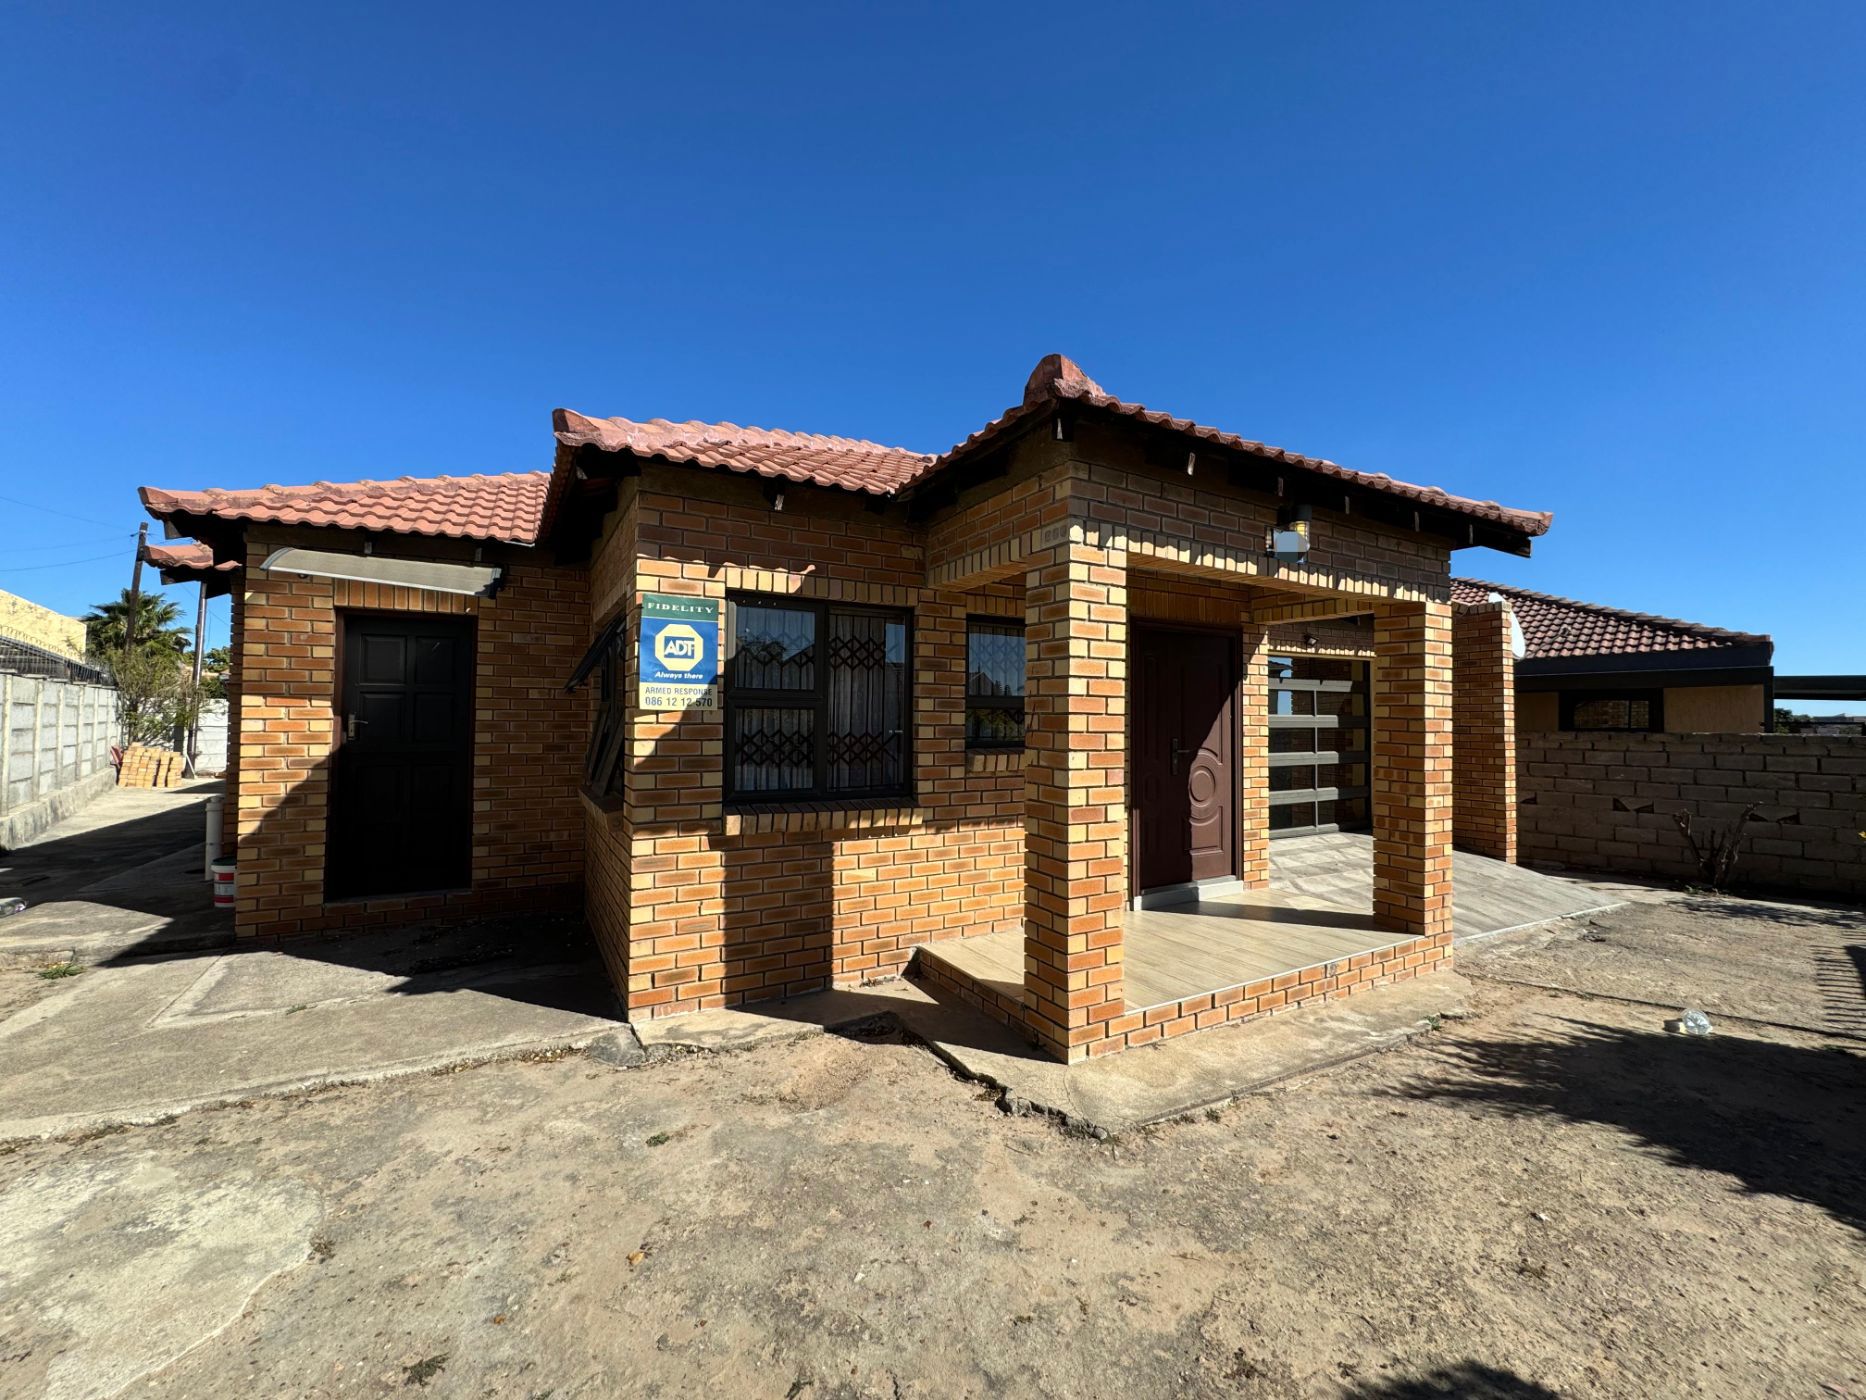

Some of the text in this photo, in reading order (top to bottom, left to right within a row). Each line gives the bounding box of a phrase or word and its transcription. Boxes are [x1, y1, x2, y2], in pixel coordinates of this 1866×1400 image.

[647, 602, 714, 614] FIDELITY
[664, 640, 695, 656] ADT
[655, 671, 704, 680] Always there
[645, 686, 713, 696] ARMED RESPONSE
[645, 696, 713, 707] 086 12 12 570
